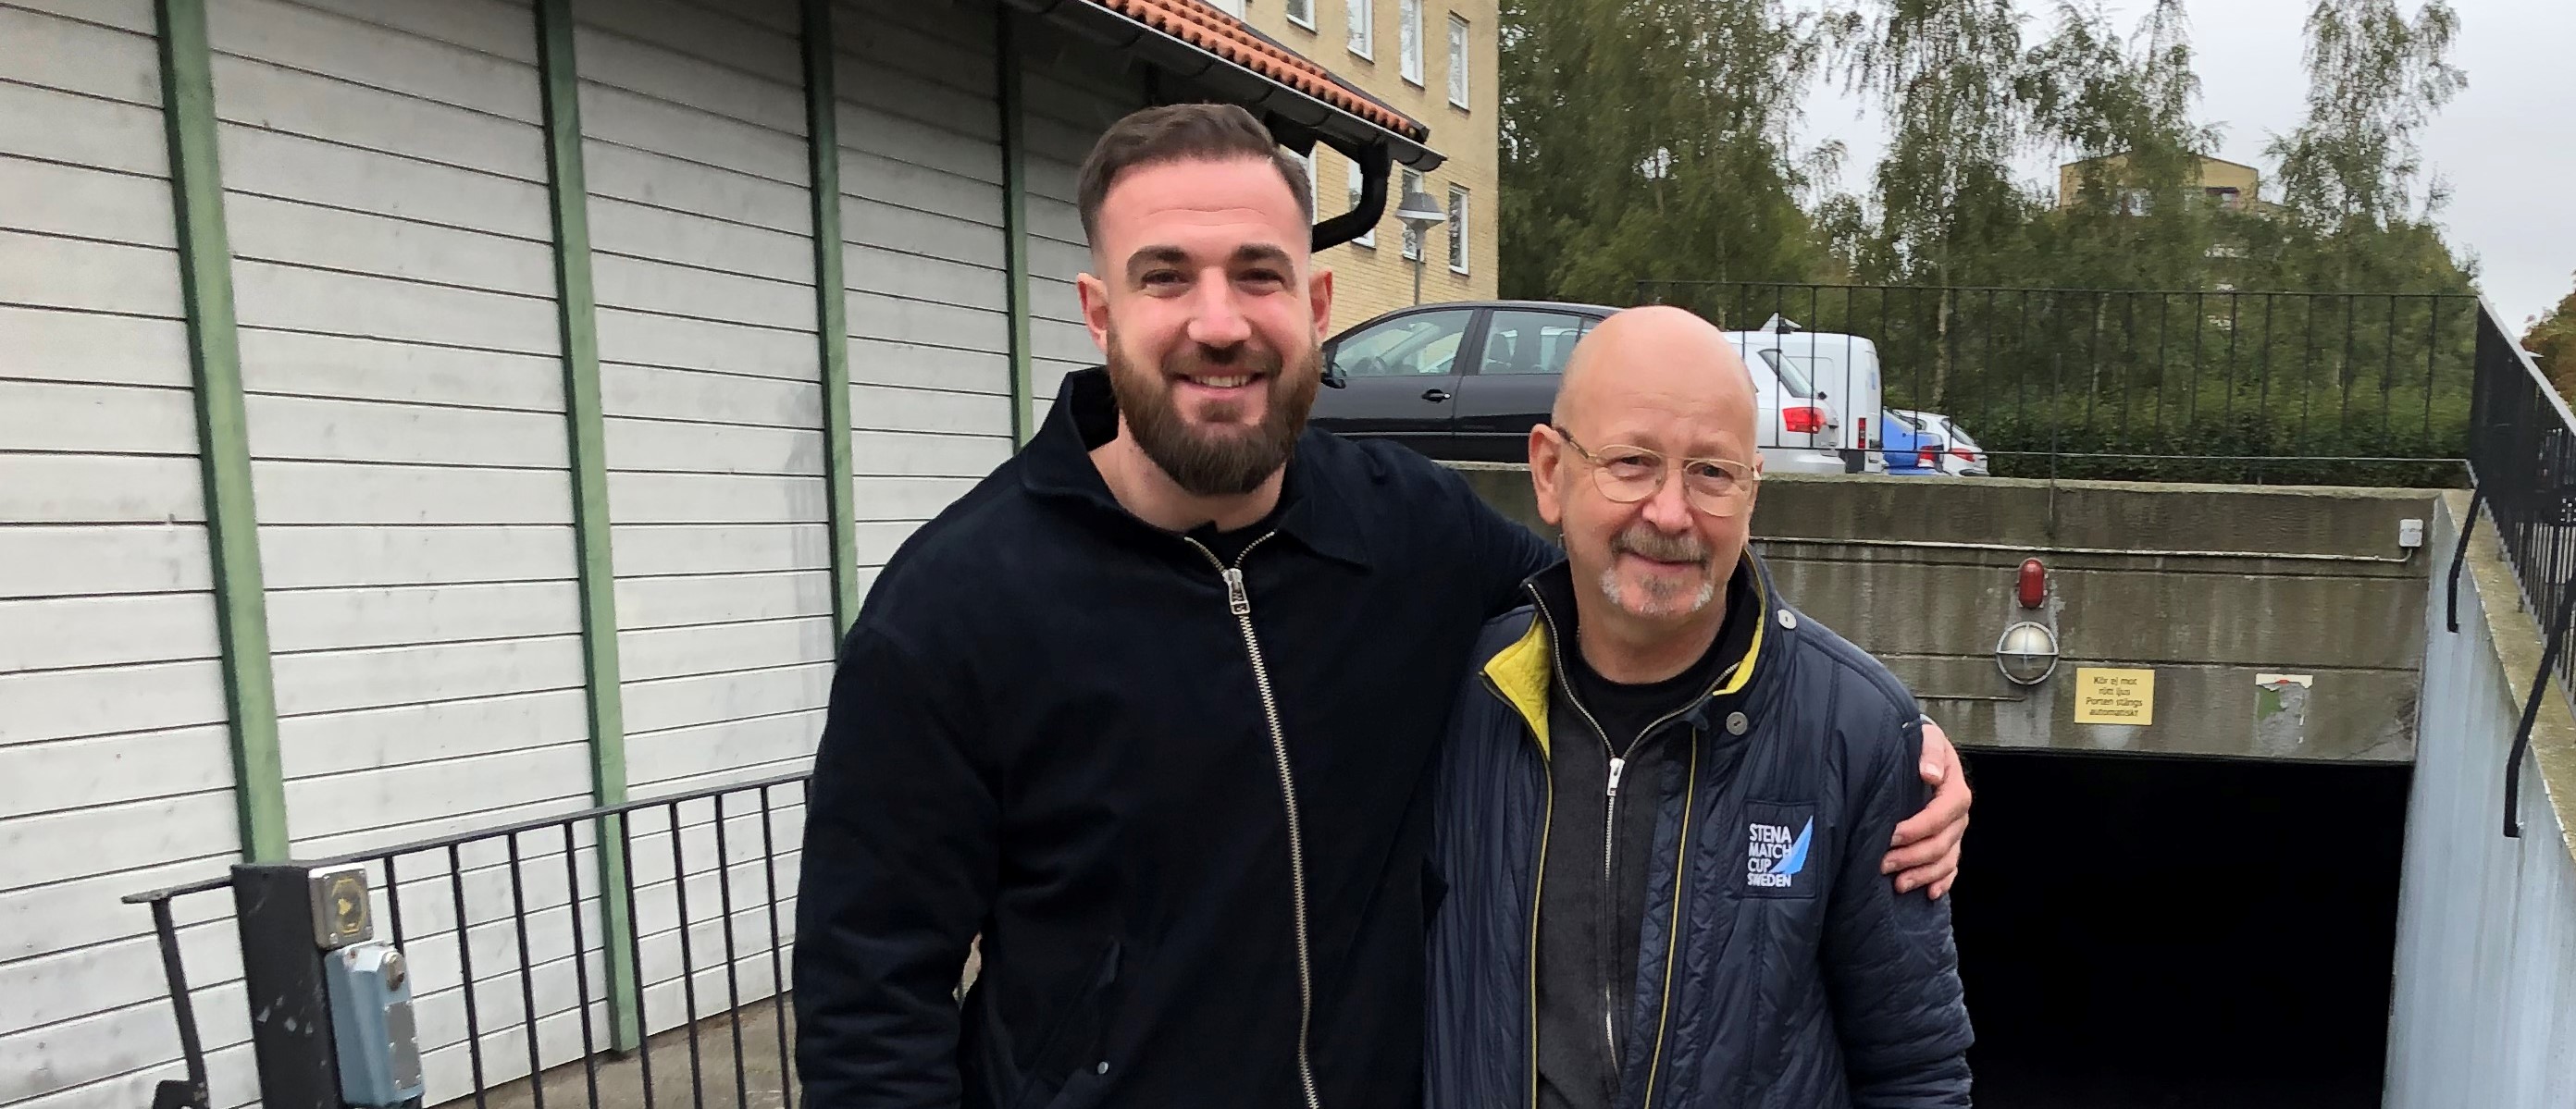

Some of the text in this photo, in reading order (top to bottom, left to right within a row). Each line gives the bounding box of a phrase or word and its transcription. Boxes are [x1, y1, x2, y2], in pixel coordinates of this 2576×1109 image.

[2111, 677, 2118, 686] ej
[2086, 696, 2114, 706] Porten
[1749, 822, 1792, 844] STENA
[1748, 842, 1792, 859] MATCH
[1747, 857, 1772, 873] CUP
[1747, 872, 1792, 888] SWEDEN
